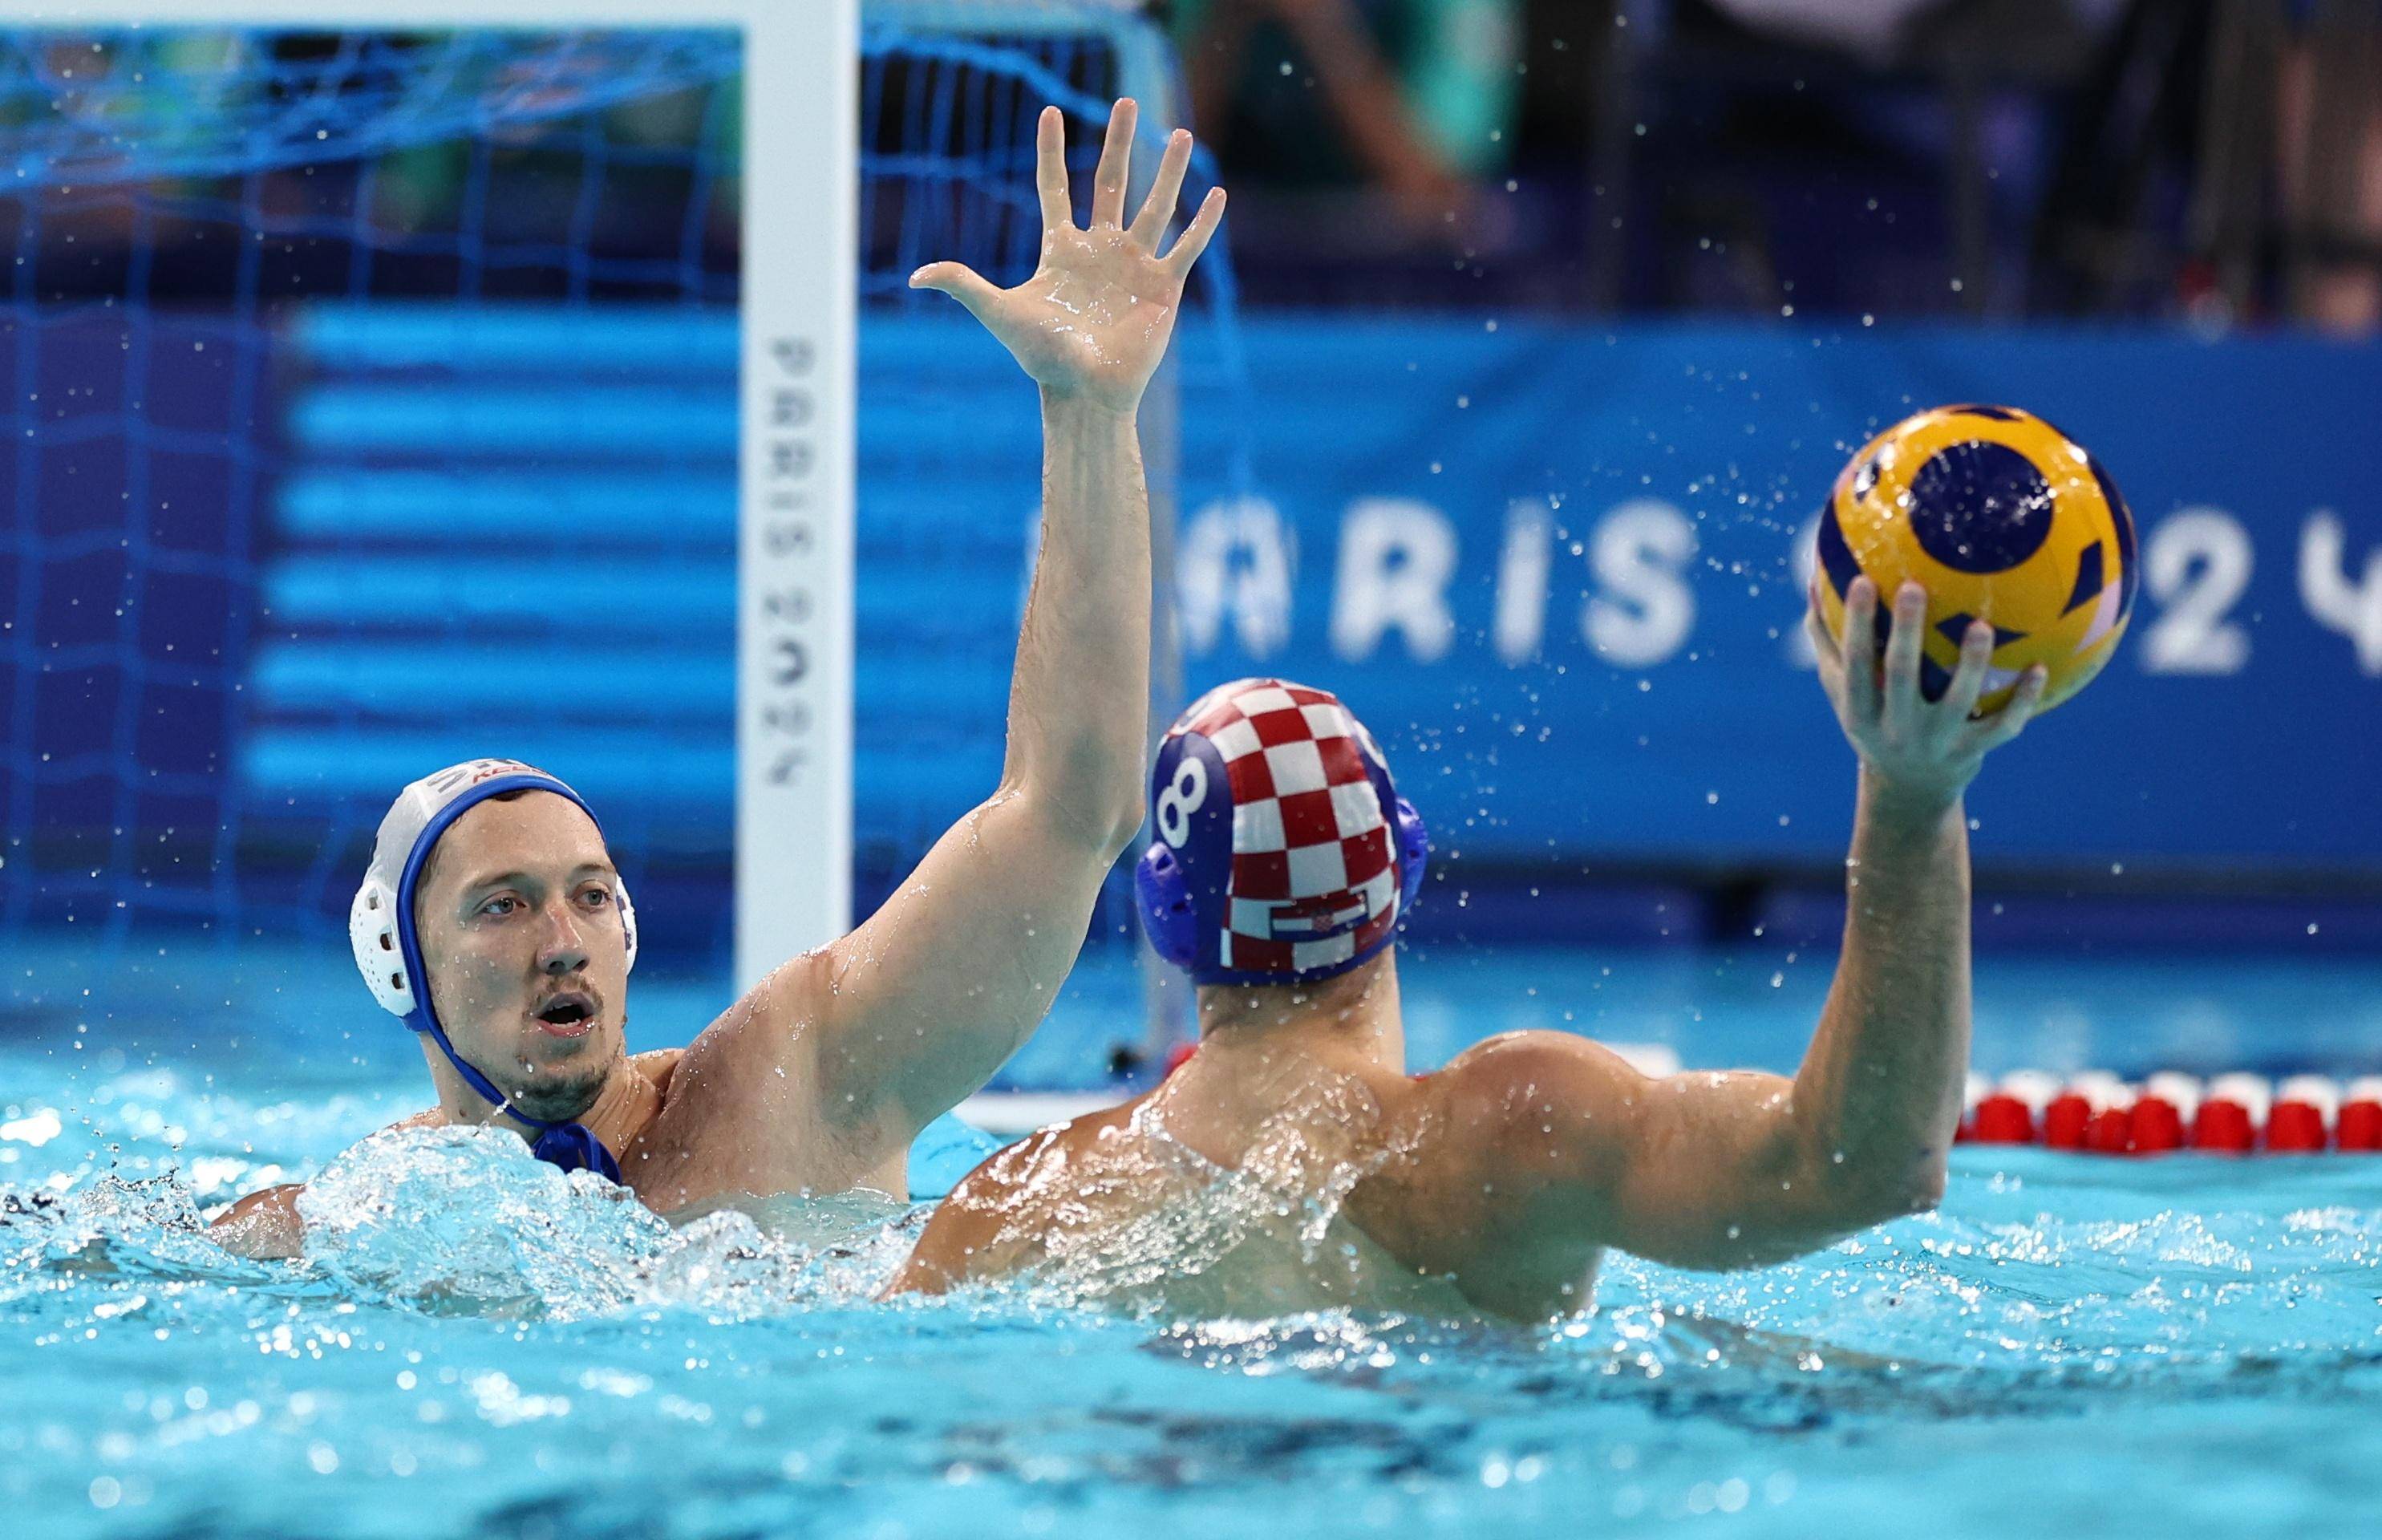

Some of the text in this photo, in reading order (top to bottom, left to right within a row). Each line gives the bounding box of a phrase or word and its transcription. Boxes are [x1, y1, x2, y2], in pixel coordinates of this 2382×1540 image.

[764, 336, 816, 557] PARIS
[1022, 494, 1695, 666] ARIS
[1157, 756, 1208, 849] 8
